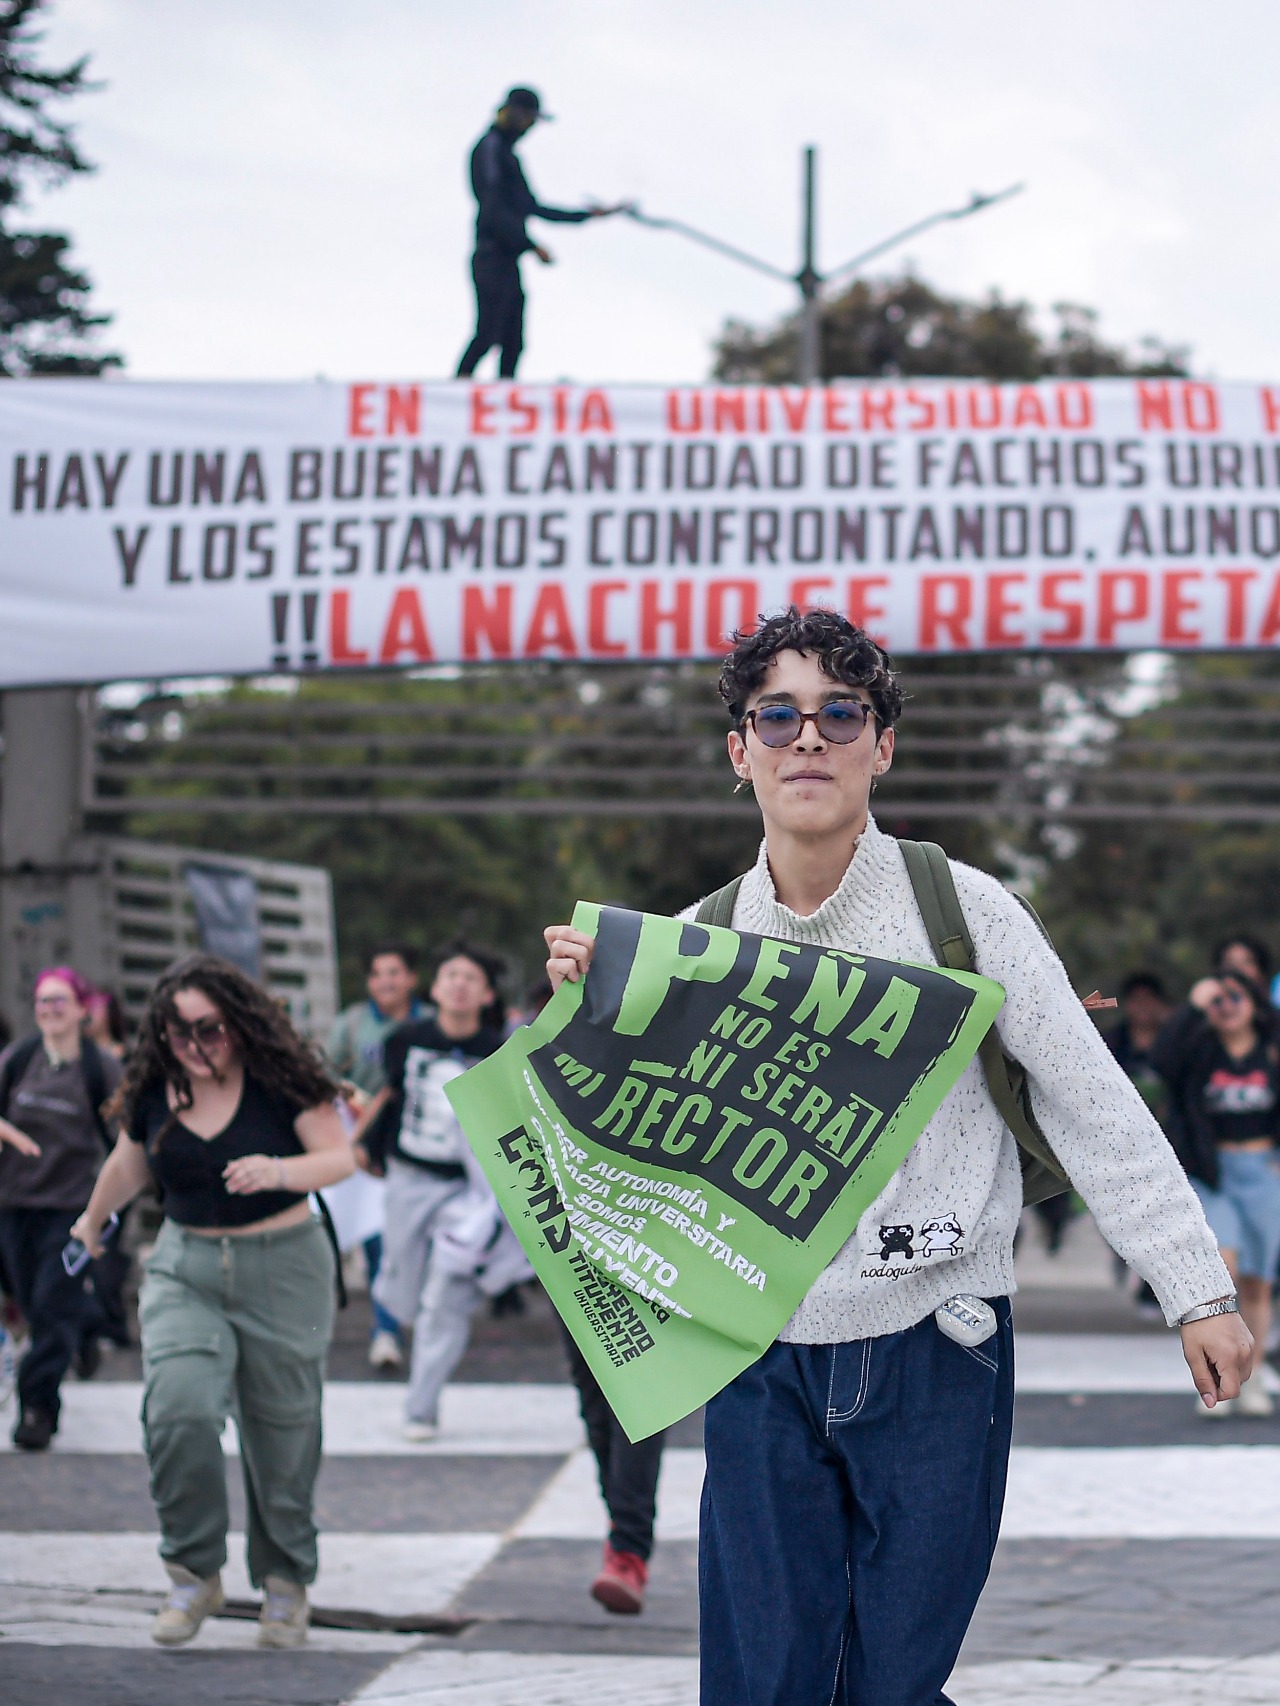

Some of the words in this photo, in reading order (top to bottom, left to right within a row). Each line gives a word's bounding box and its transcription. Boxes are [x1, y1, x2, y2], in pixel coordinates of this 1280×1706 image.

[348, 382, 422, 439] EN
[665, 381, 1094, 436] UNIVERSIDAD
[1135, 380, 1222, 434] NO
[12, 452, 130, 512] HAY
[147, 450, 268, 508] UNA
[288, 446, 484, 503] BUENA
[507, 442, 804, 496] CANTIDAD
[827, 442, 896, 490] DE
[918, 440, 1147, 489] FACHOS
[113, 524, 150, 588] Y
[167, 520, 277, 584] LOS
[294, 512, 567, 578] ESTAMOS
[459, 577, 760, 663] NACHO
[612, 914, 922, 1060] PEÑA
[678, 1039, 738, 1089] NI
[708, 1003, 773, 1049] NO
[773, 1031, 831, 1073] ES
[552, 1052, 606, 1098] MI
[591, 1075, 830, 1220] RECTOR
[573, 1191, 649, 1235] SOMOS
[588, 1160, 710, 1219] AUTONOMÍA
[715, 1211, 738, 1234] Y
[615, 1191, 768, 1293] UNIVERSITARIA
[568, 1249, 642, 1363] TITUYENTE
[572, 1288, 625, 1369] UNIVERSITARIA
